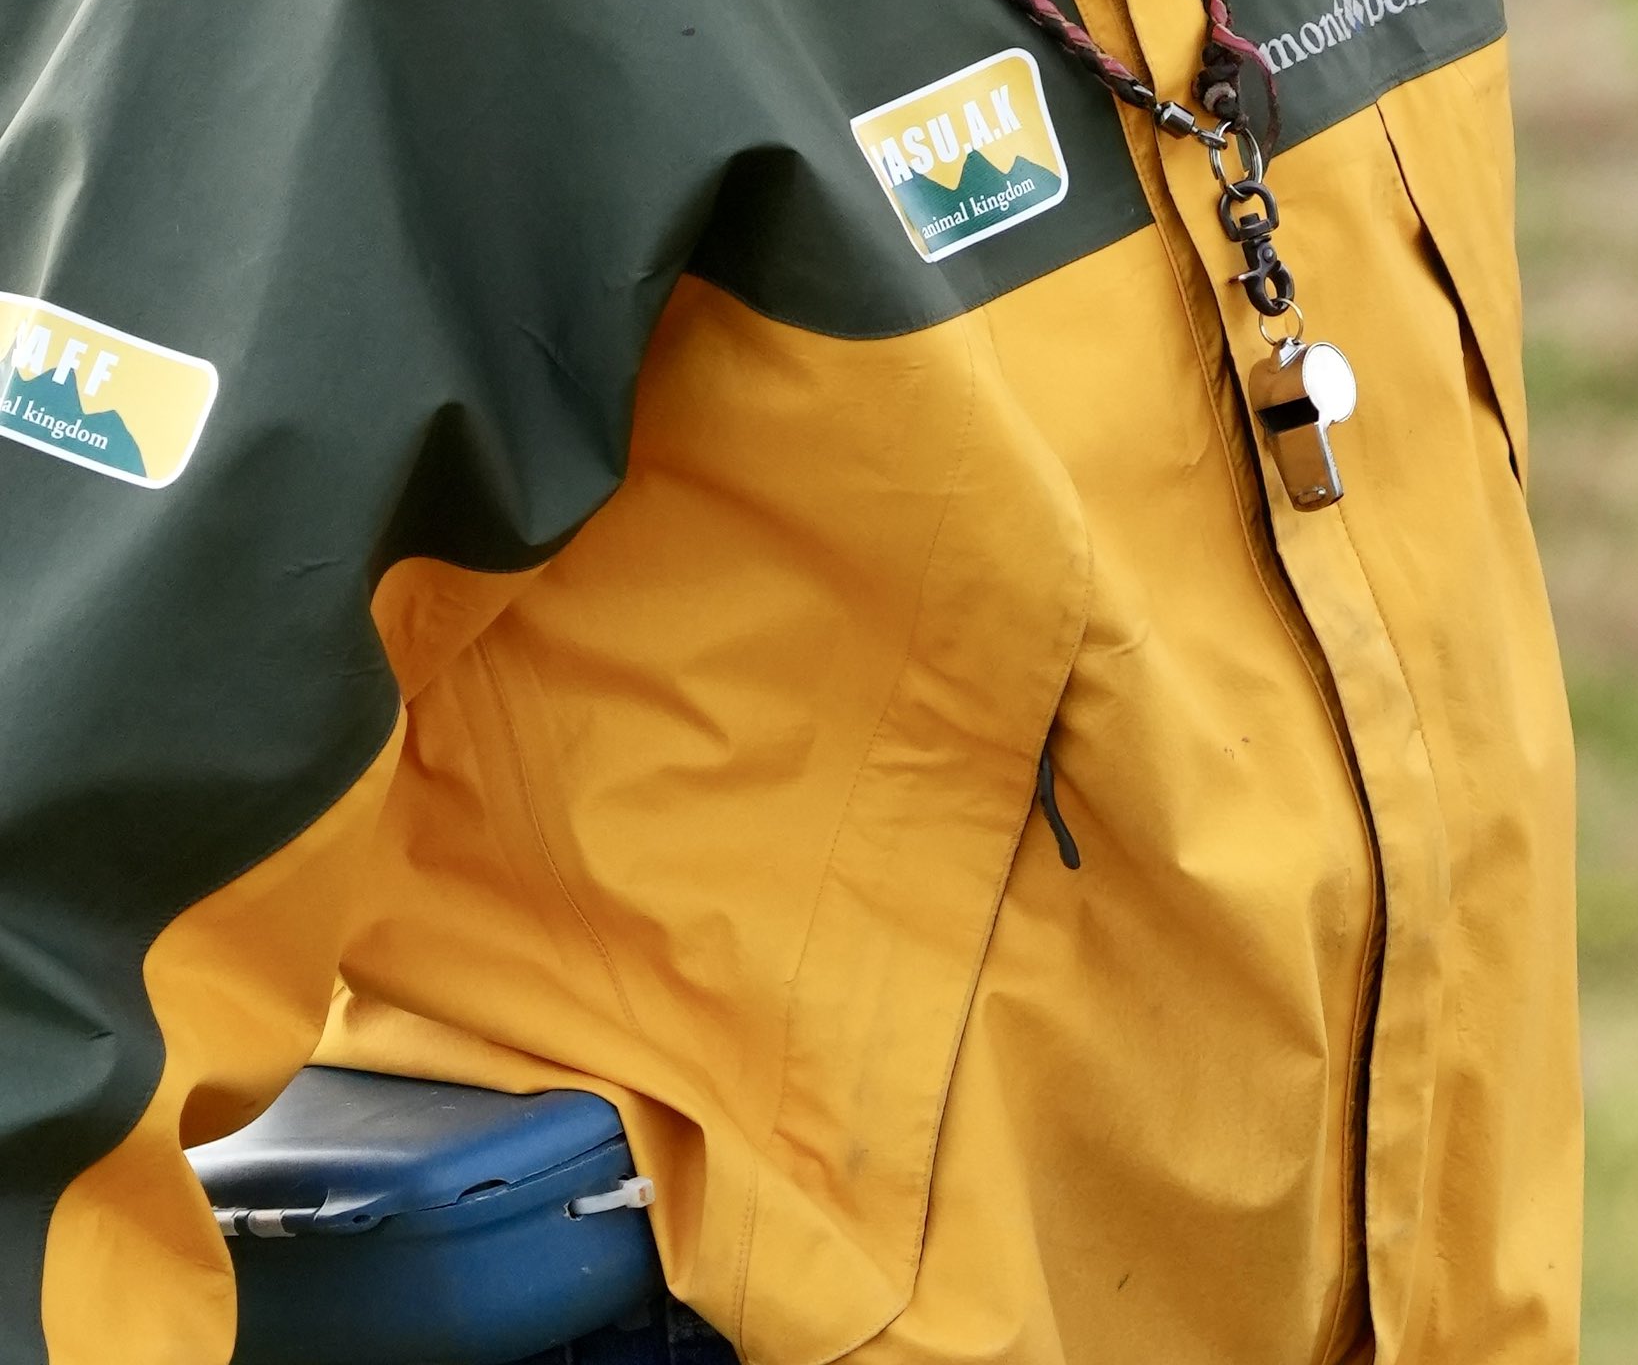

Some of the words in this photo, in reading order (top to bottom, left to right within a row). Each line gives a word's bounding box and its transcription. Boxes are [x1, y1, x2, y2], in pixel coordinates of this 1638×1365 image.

[921, 202, 970, 239] animal
[968, 177, 1036, 212] kingdom
[22, 399, 109, 451] kingdom
